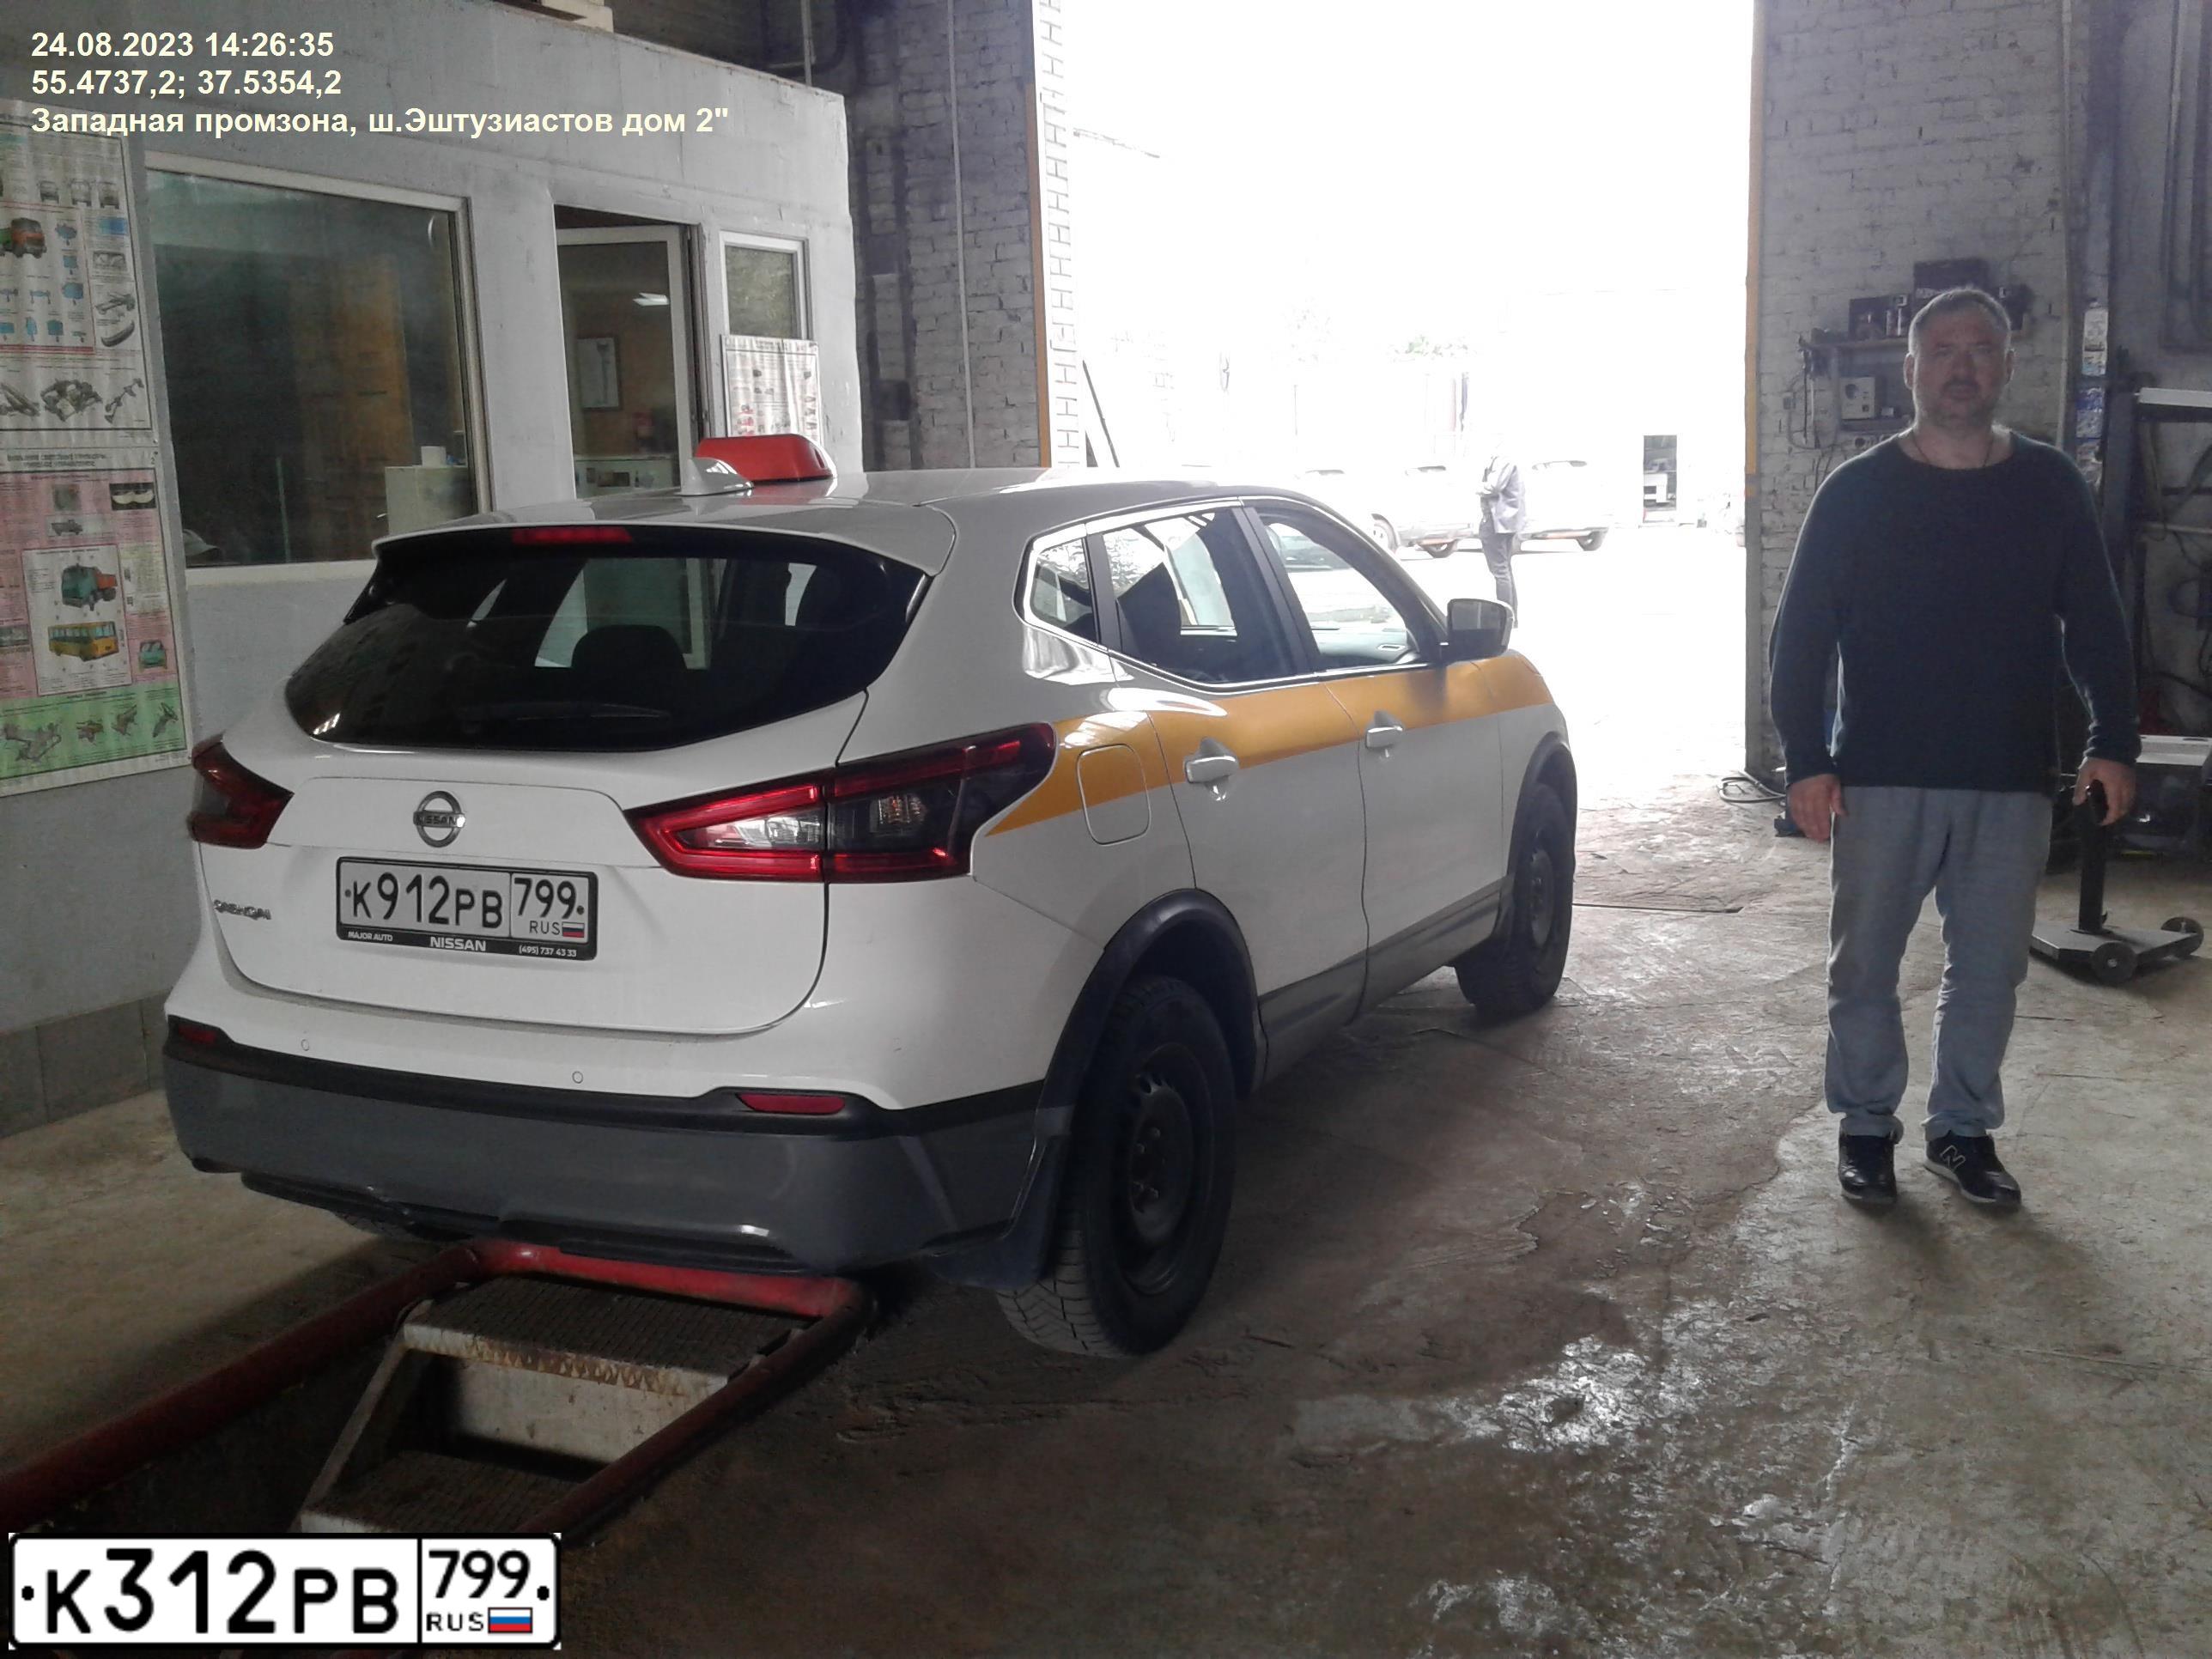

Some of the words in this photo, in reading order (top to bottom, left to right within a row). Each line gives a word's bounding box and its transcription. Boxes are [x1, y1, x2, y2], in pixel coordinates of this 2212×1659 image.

[514, 877, 577, 920] 799
[529, 921, 561, 935] RUS
[348, 931, 373, 940] MAJOR
[374, 933, 393, 942] AUTO
[430, 936, 486, 951] NISSAN
[519, 945, 539, 955] (495)
[540, 947, 555, 956] 737
[567, 949, 577, 957] 33
